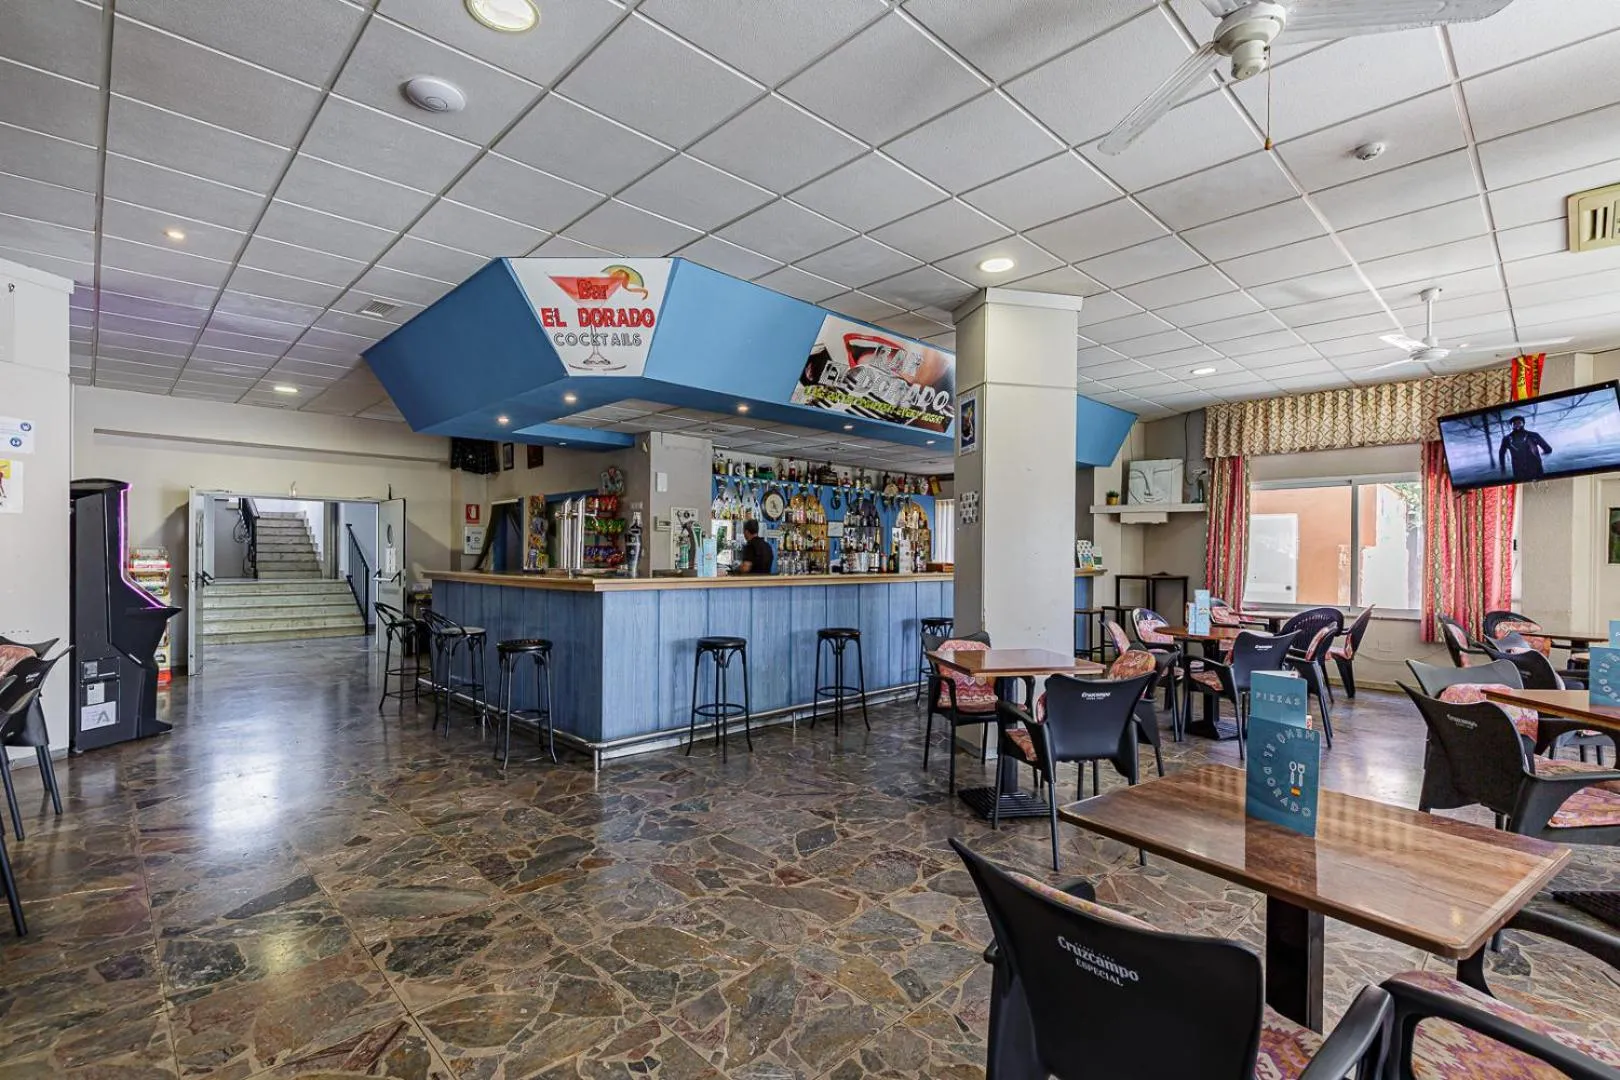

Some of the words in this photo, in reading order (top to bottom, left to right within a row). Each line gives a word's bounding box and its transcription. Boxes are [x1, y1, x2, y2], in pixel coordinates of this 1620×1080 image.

[577, 278, 609, 300] Bar
[540, 307, 568, 328] EL
[577, 307, 656, 329] DORADO
[553, 332, 643, 348] COCKTAILS
[1256, 691, 1300, 706] PIZZAS
[1057, 935, 1139, 982] Cruzcampo
[1075, 958, 1124, 987] ESPECIAL
